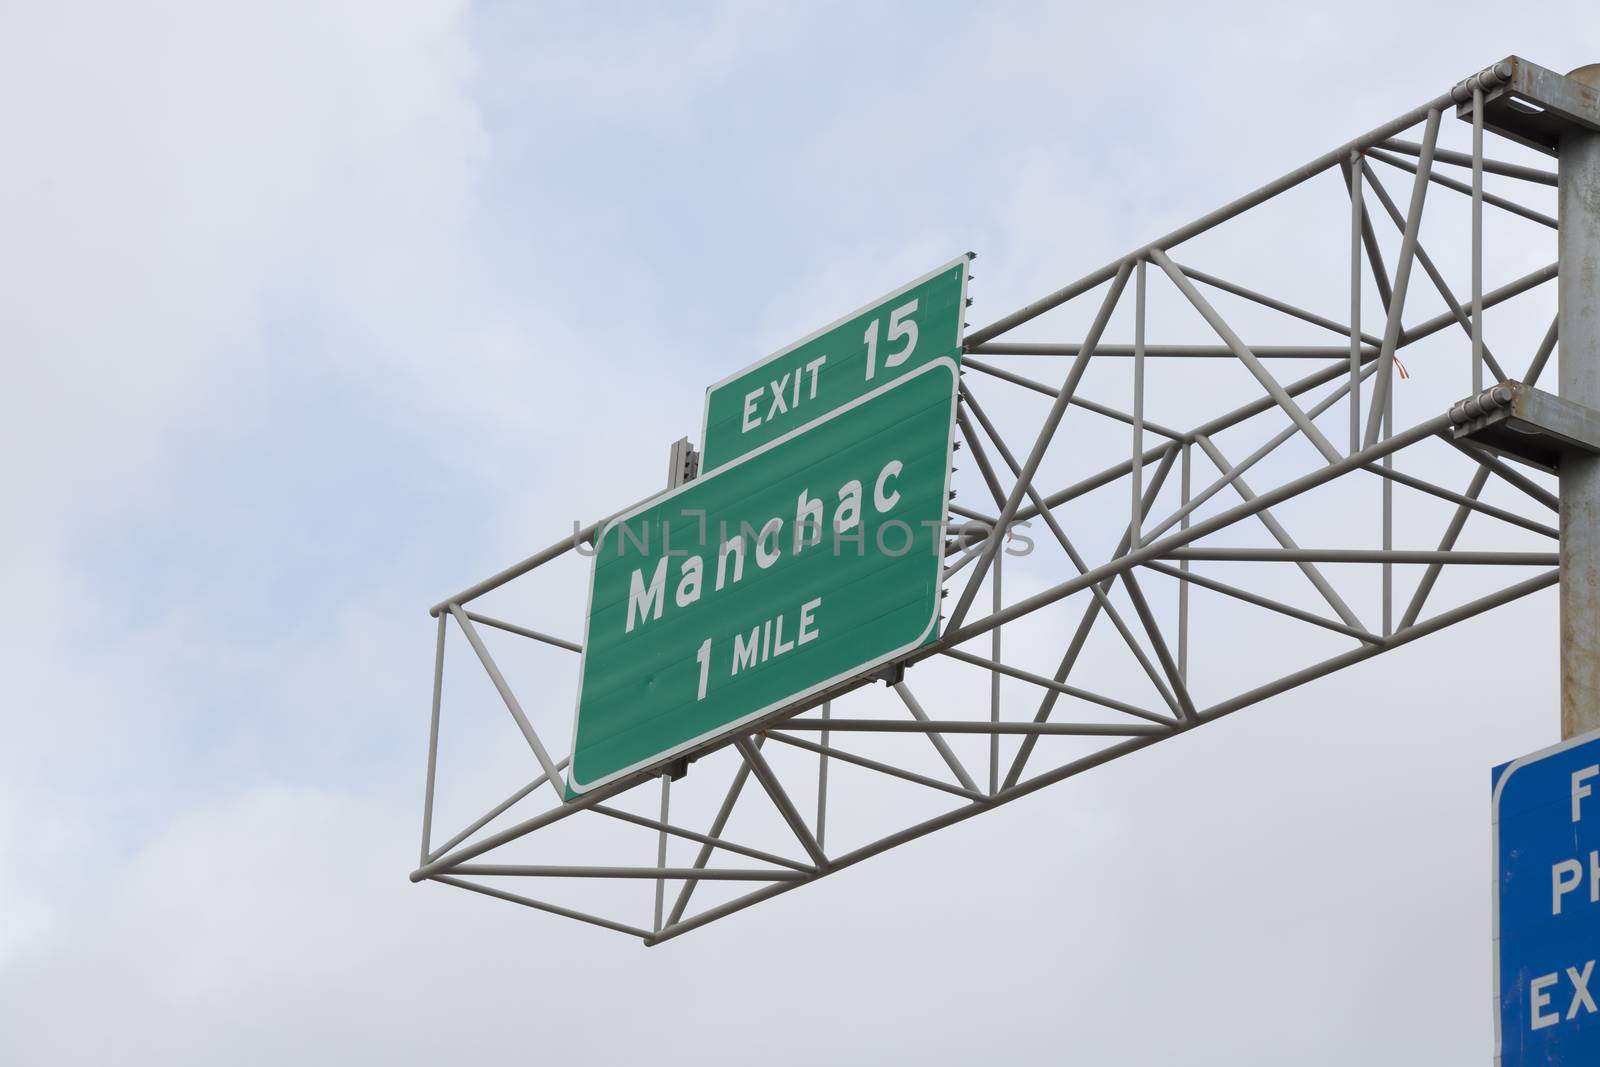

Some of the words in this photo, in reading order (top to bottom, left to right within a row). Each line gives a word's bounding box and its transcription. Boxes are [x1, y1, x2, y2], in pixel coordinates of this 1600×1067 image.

[742, 355, 827, 433] EXIT
[863, 298, 919, 381] 15
[625, 460, 903, 633] Manchac
[696, 638, 712, 701] 1
[731, 597, 821, 676] MILE
